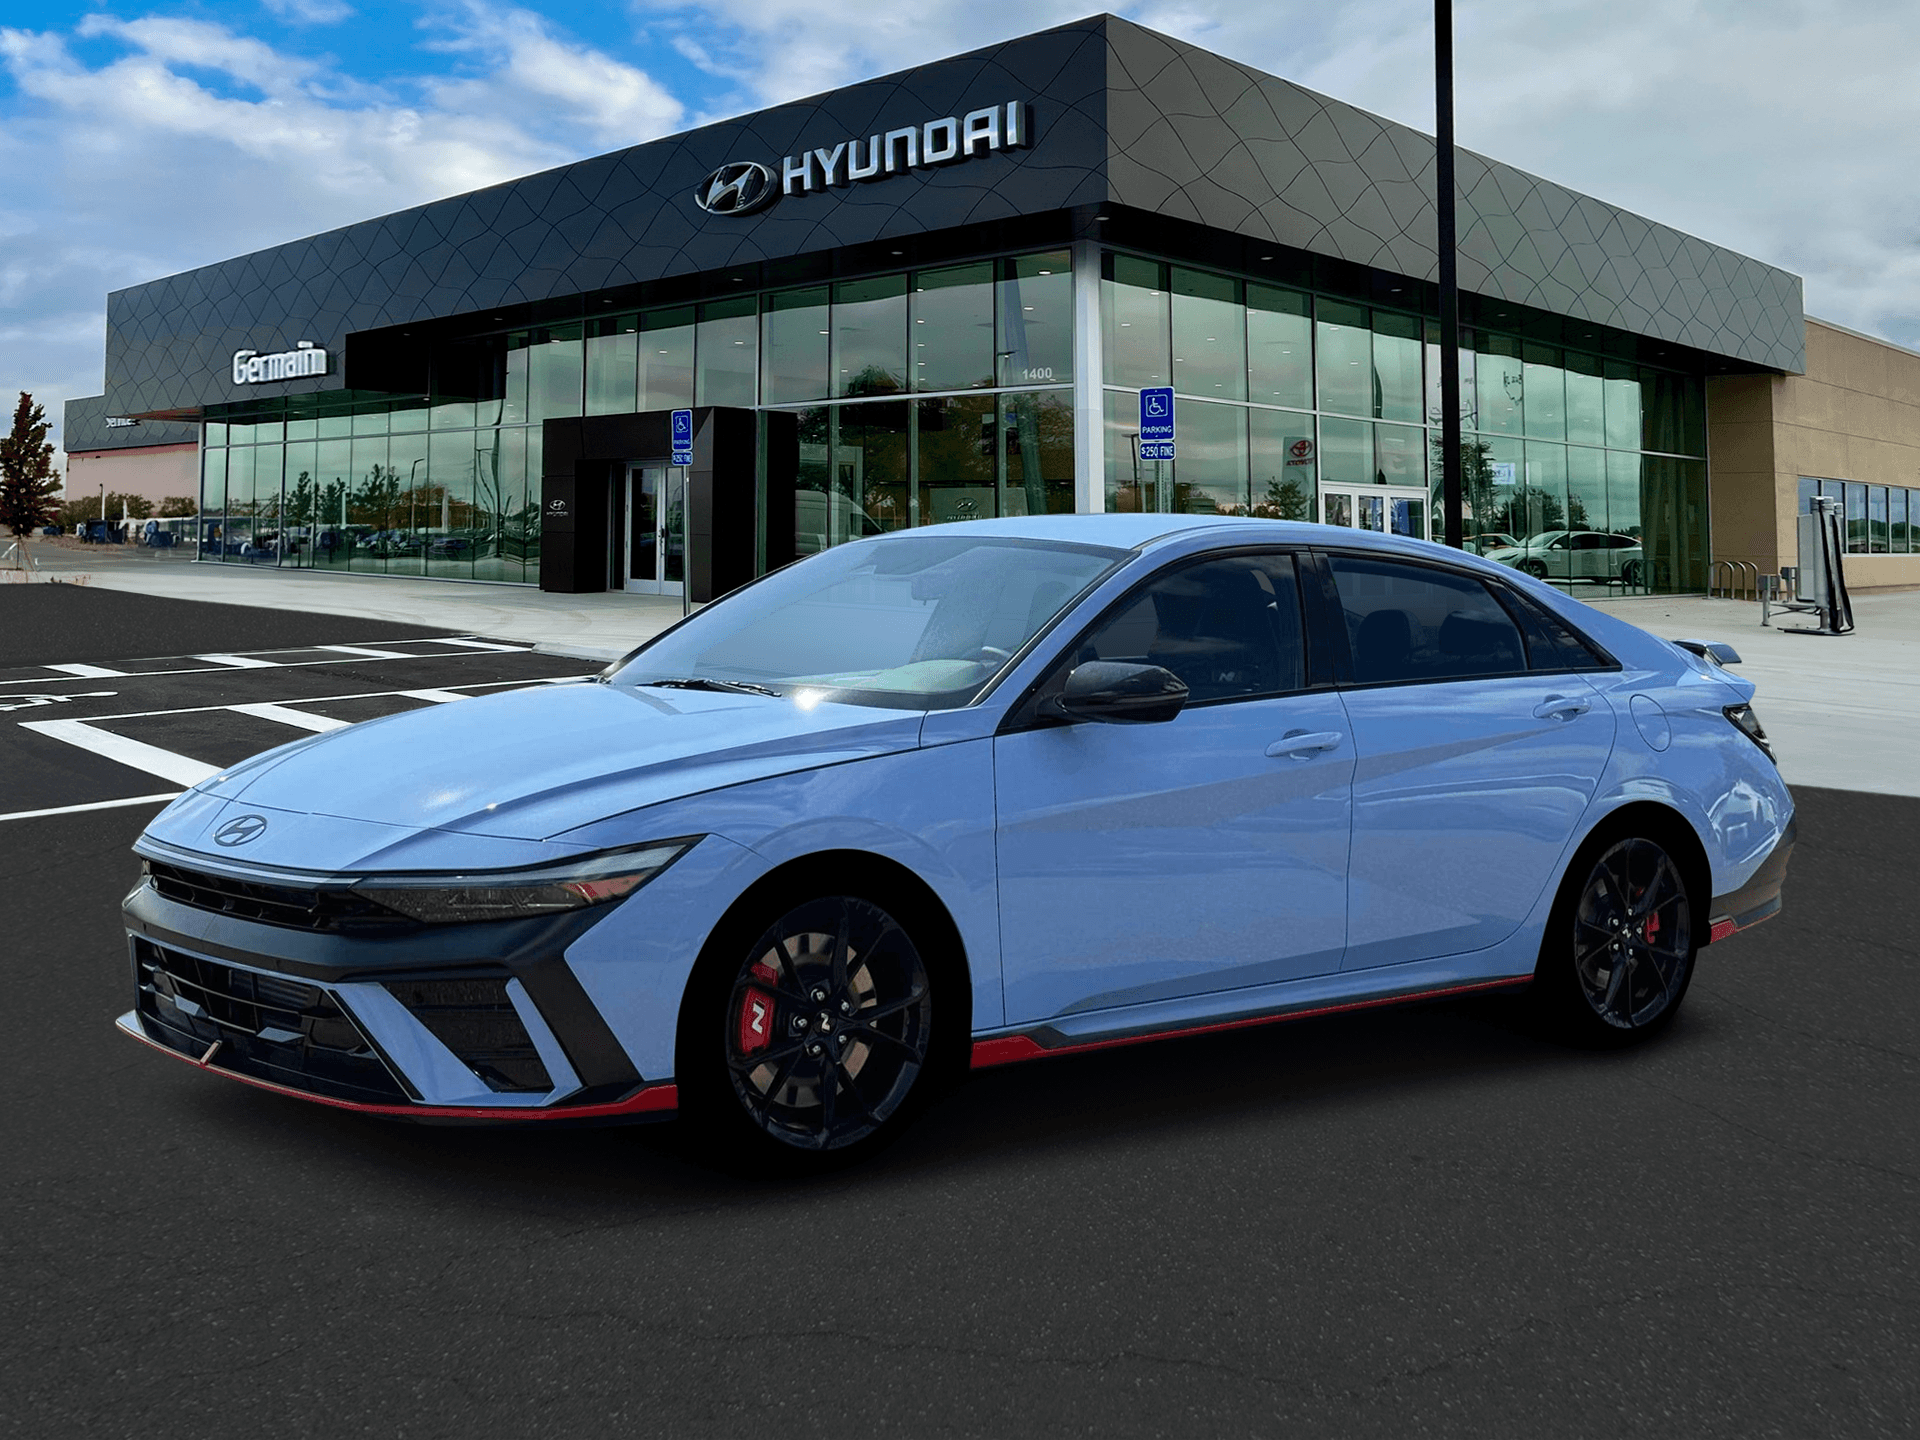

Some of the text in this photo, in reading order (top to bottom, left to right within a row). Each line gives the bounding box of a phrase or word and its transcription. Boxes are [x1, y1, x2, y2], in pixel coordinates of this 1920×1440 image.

[783, 100, 1026, 195] HYUNDAI
[233, 341, 327, 385] Germain
[1022, 367, 1052, 380] 1400
[1142, 425, 1172, 434] PARKING
[1141, 445, 1174, 458] $250 FINE
